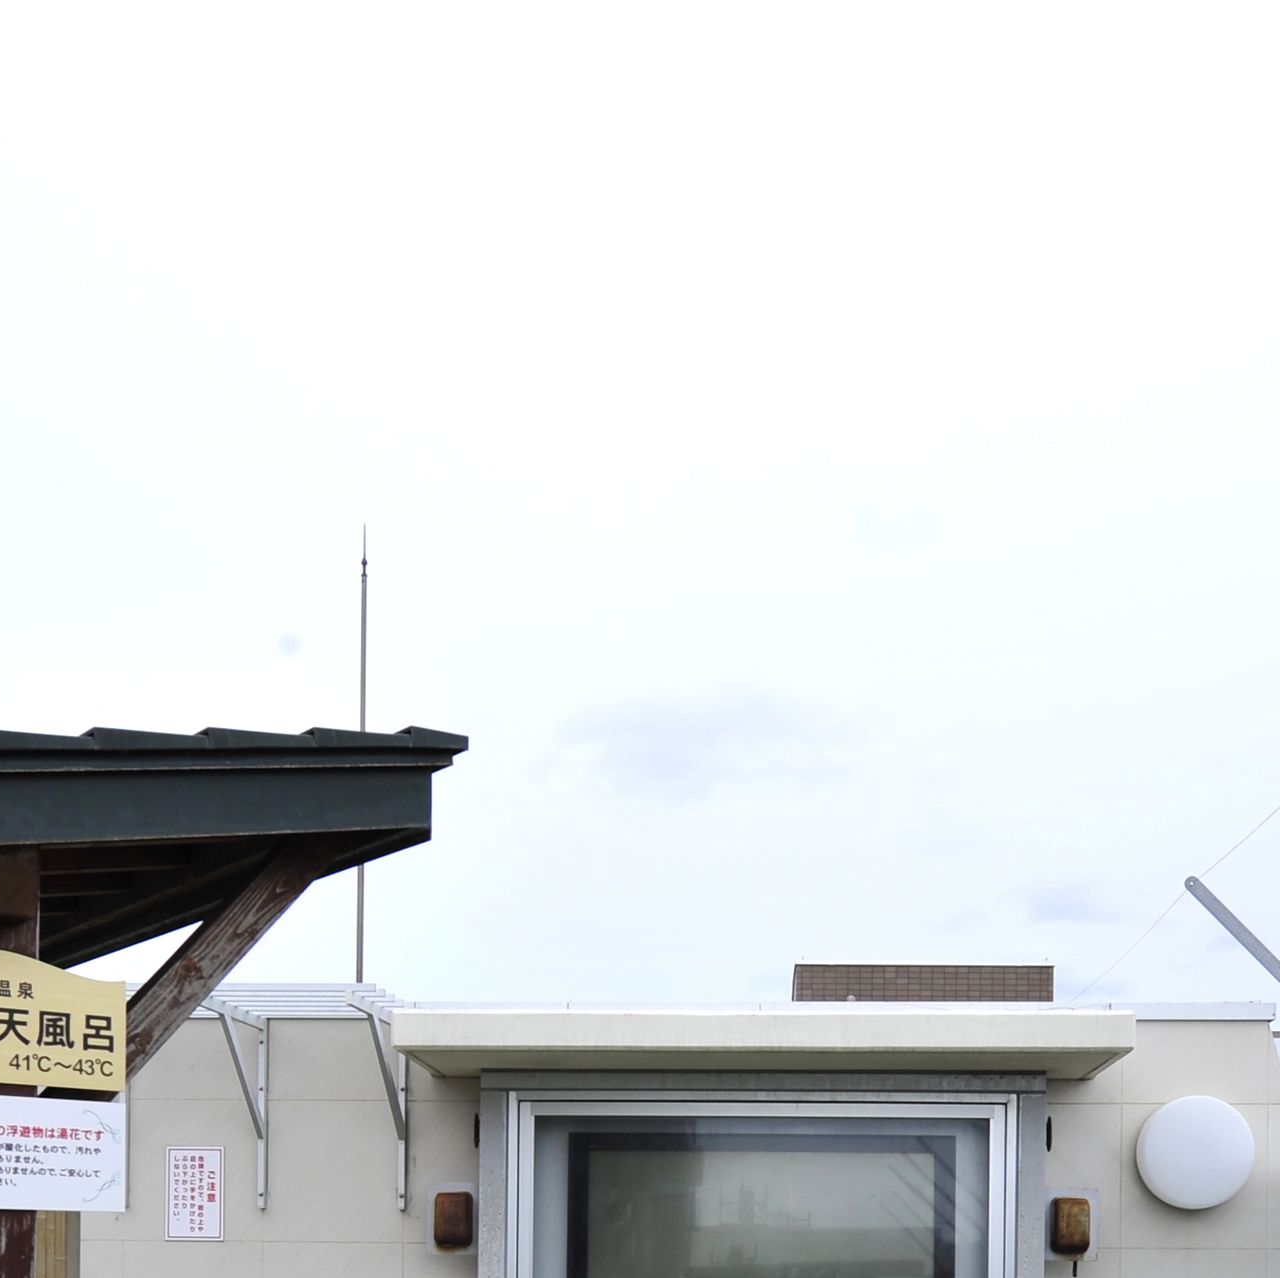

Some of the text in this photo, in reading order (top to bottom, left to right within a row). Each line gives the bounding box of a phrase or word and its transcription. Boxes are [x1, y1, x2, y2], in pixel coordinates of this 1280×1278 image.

[173, 1155, 181, 1221] しないでください。
[206, 1170, 216, 1203] ご注意
